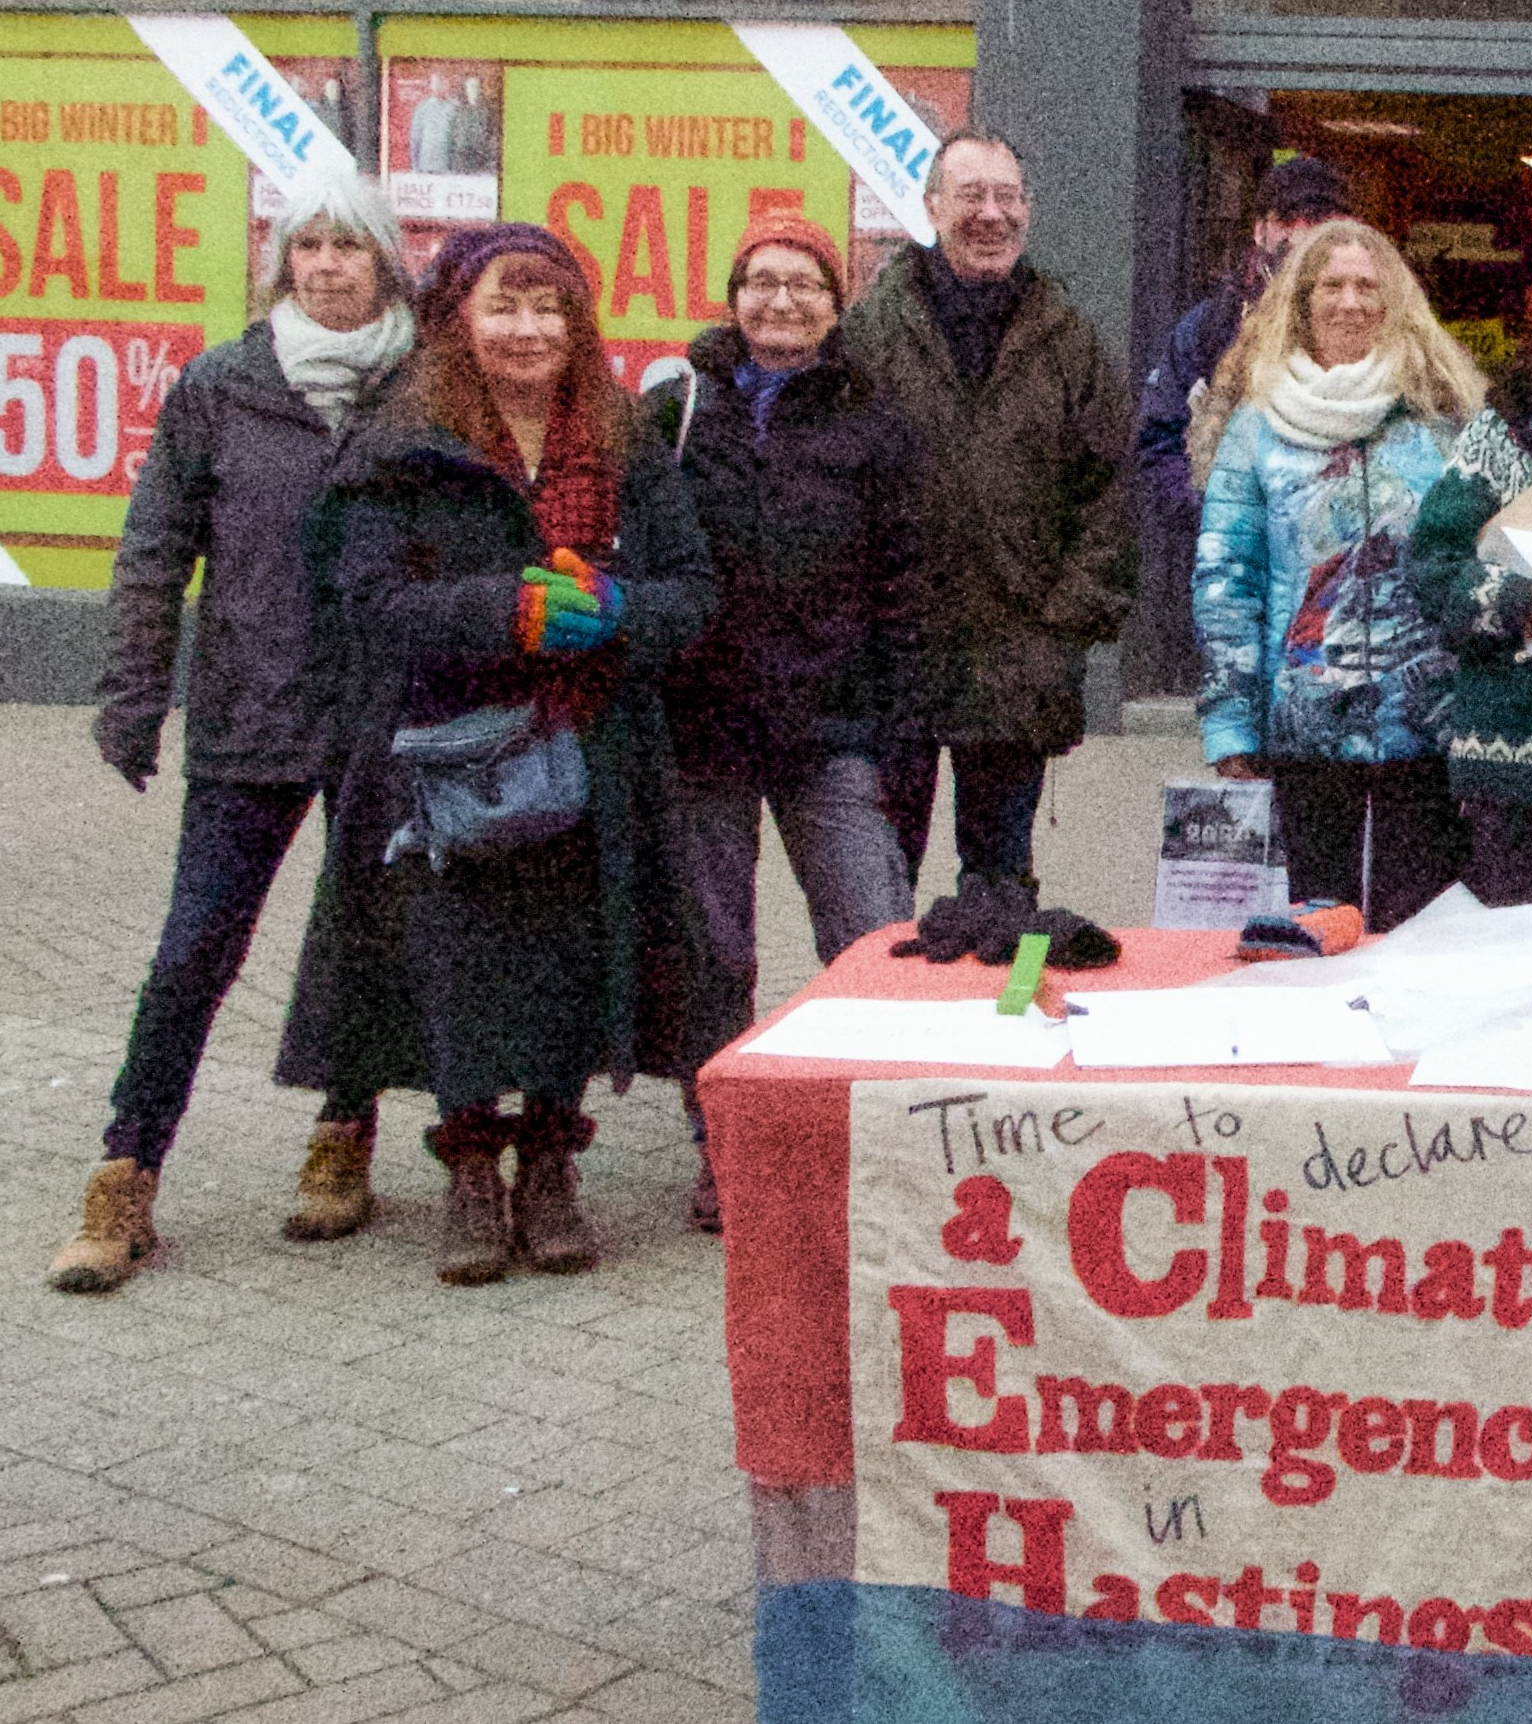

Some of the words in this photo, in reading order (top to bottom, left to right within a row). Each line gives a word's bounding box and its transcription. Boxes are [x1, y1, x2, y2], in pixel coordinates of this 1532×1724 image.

[61, 103, 178, 146] WINTER
[222, 53, 315, 162] FINAL
[581, 114, 634, 156] BIG
[646, 115, 774, 160] WINTER
[814, 90, 910, 198] REDUCTIONS
[832, 64, 931, 181] FINAL
[546, 181, 805, 322] SAL
[909, 1092, 1106, 1175] Time
[1178, 1095, 1242, 1150] to
[940, 1175, 1024, 1266] a
[1145, 1494, 1209, 1545] in
